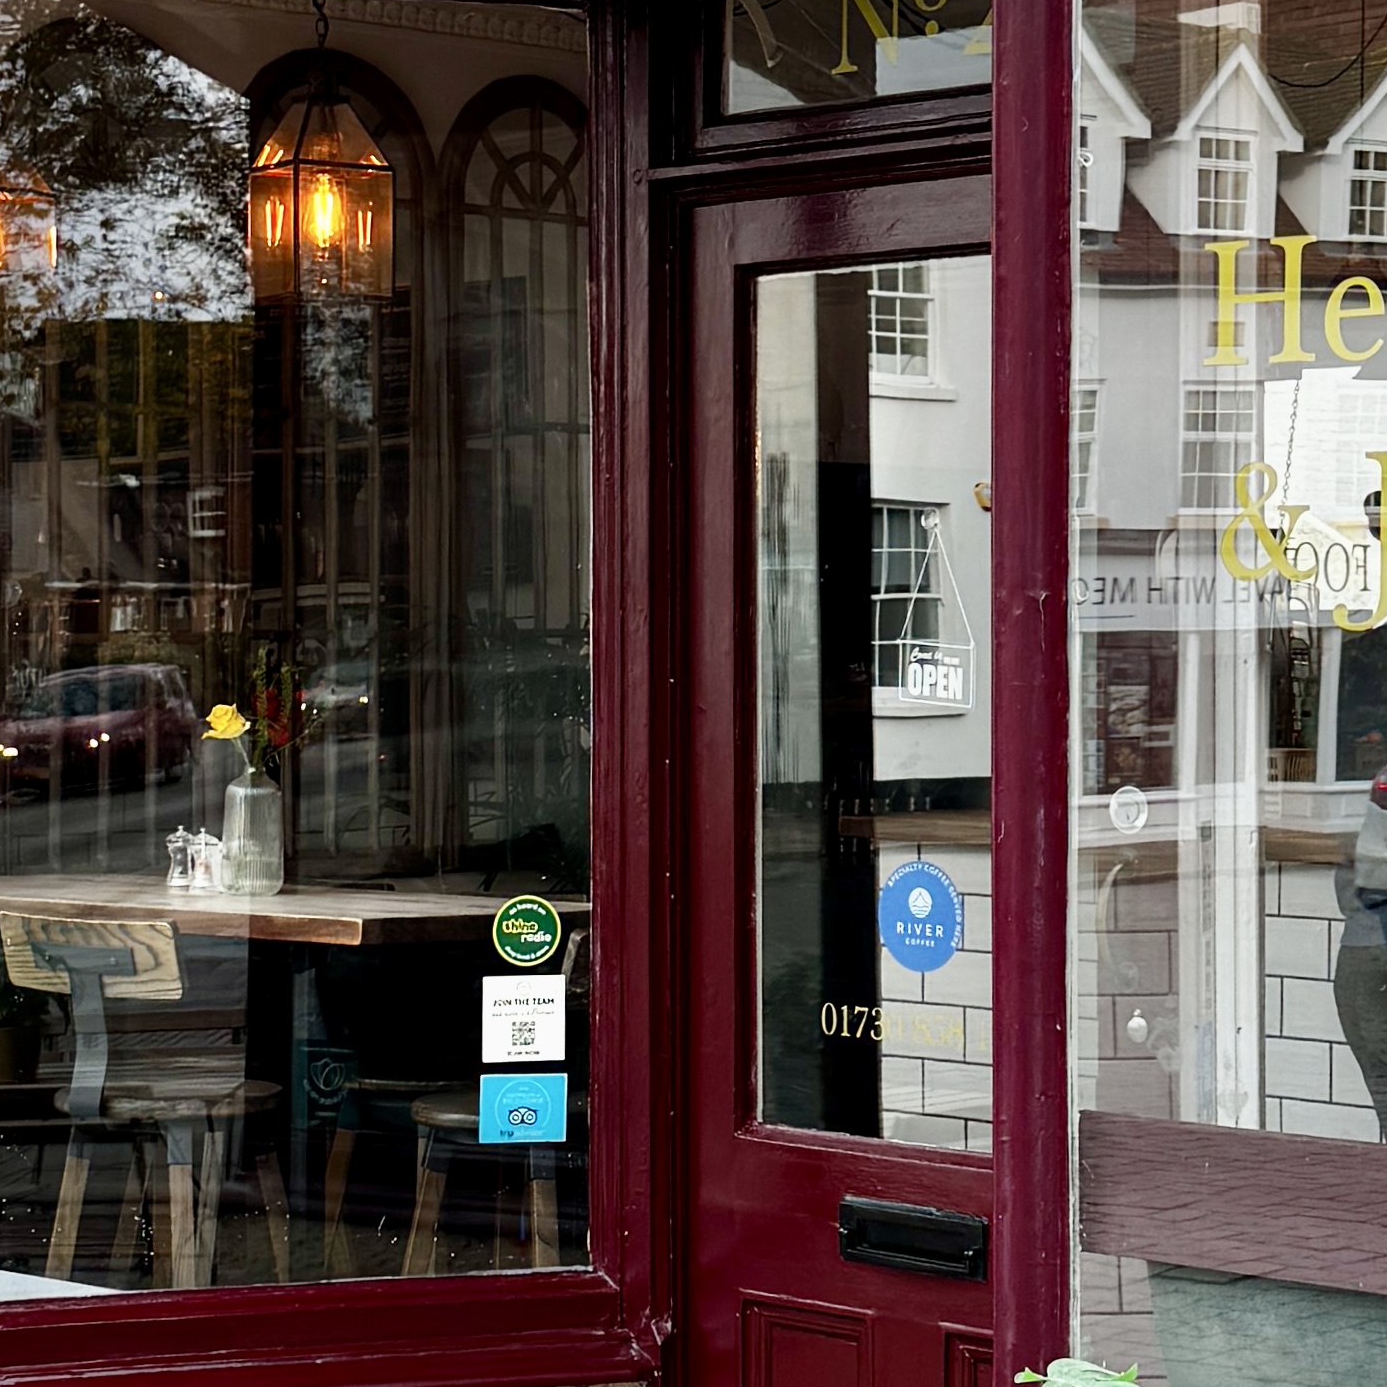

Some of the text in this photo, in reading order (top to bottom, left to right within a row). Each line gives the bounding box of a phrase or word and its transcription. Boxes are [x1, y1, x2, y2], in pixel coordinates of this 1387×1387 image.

[1220, 463, 1319, 583] &
[907, 662, 964, 700] OPEN
[520, 930, 552, 943] radio
[896, 920, 944, 938] RIVER
[905, 937, 935, 948] COFFEE
[532, 997, 555, 1006] TEAM
